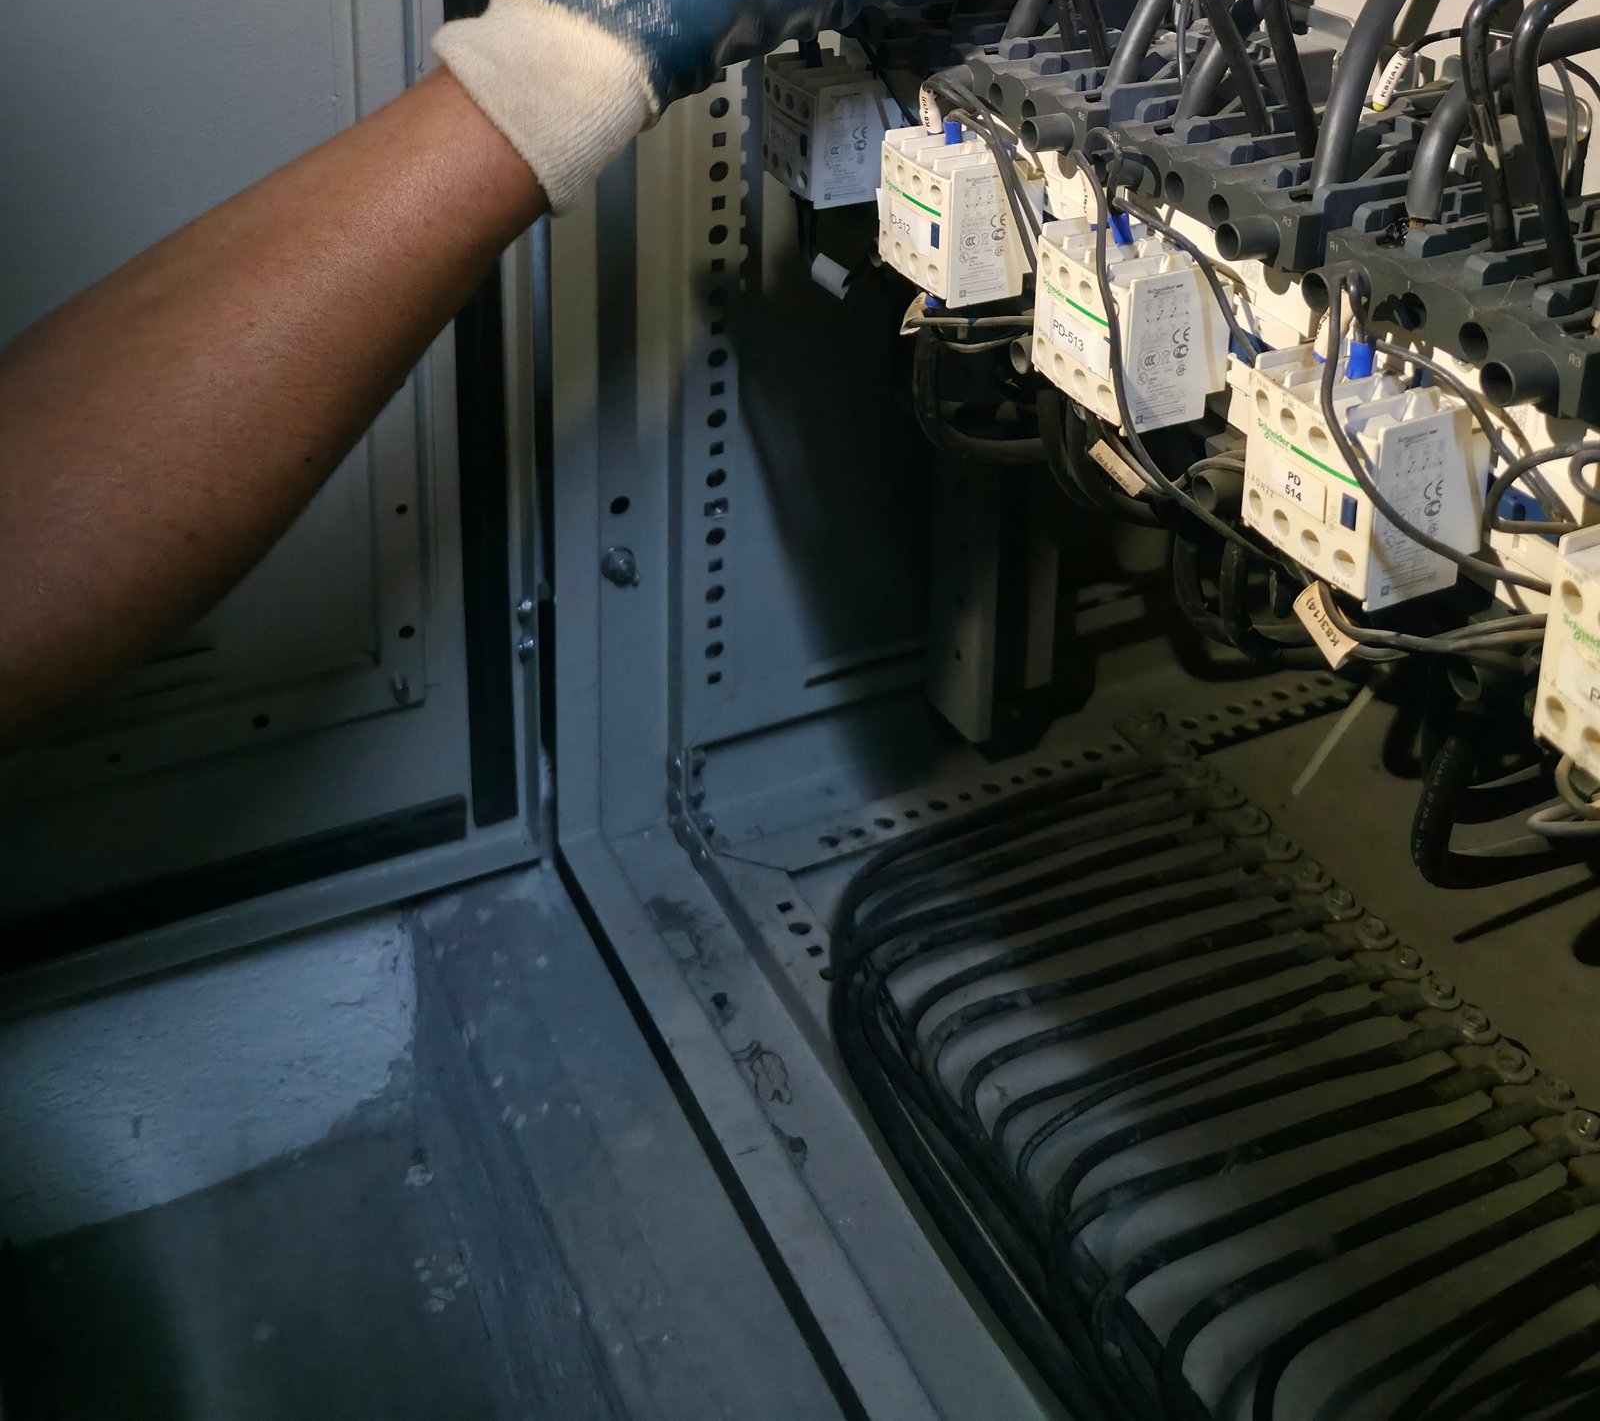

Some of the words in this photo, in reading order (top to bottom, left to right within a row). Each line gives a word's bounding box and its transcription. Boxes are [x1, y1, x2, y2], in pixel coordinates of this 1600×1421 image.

[990, 212, 1007, 228] CE
[1329, 240, 1339, 253] R1
[1052, 319, 1084, 352] PD-513
[1173, 327, 1191, 345] CE
[1257, 417, 1291, 448] Schneider
[1287, 470, 1301, 486] PD
[1285, 483, 1302, 502] 514
[1424, 479, 1444, 500] CE
